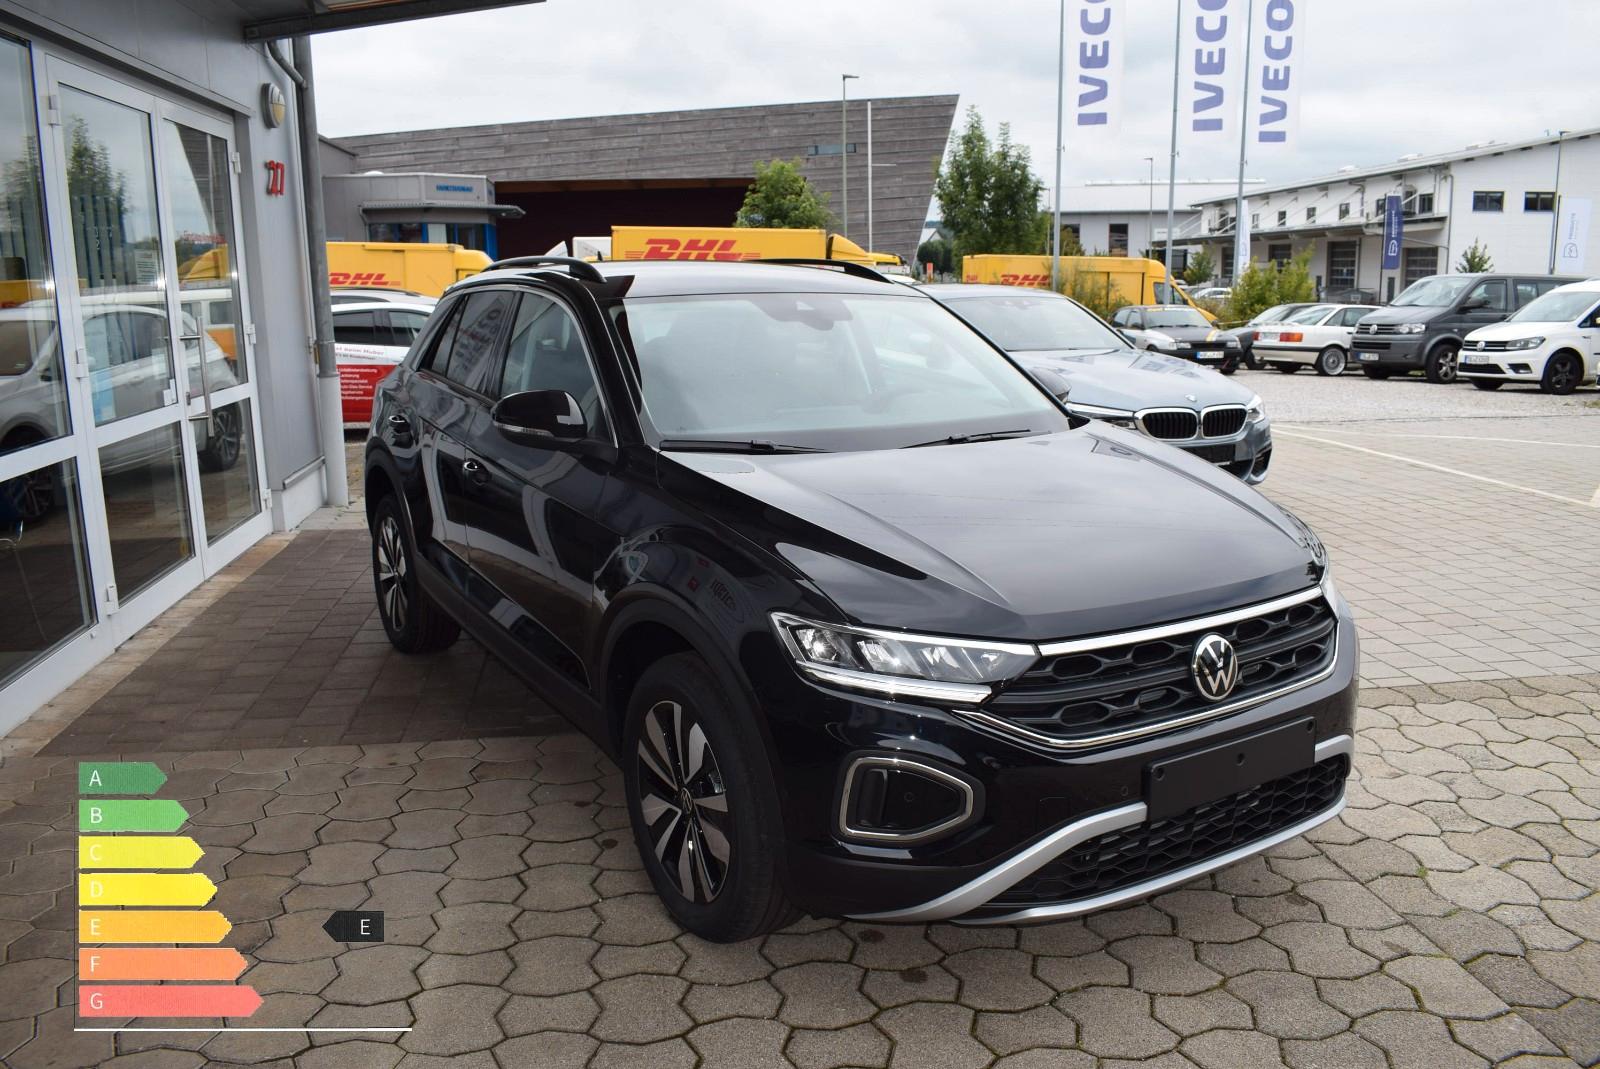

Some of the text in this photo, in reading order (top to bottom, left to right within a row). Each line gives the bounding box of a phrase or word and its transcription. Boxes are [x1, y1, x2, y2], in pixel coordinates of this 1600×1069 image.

[1077, 0, 1111, 126] IVEC
[1258, 0, 1295, 143] IVECO
[329, 272, 390, 286] DHL
[643, 238, 743, 260] DHL
